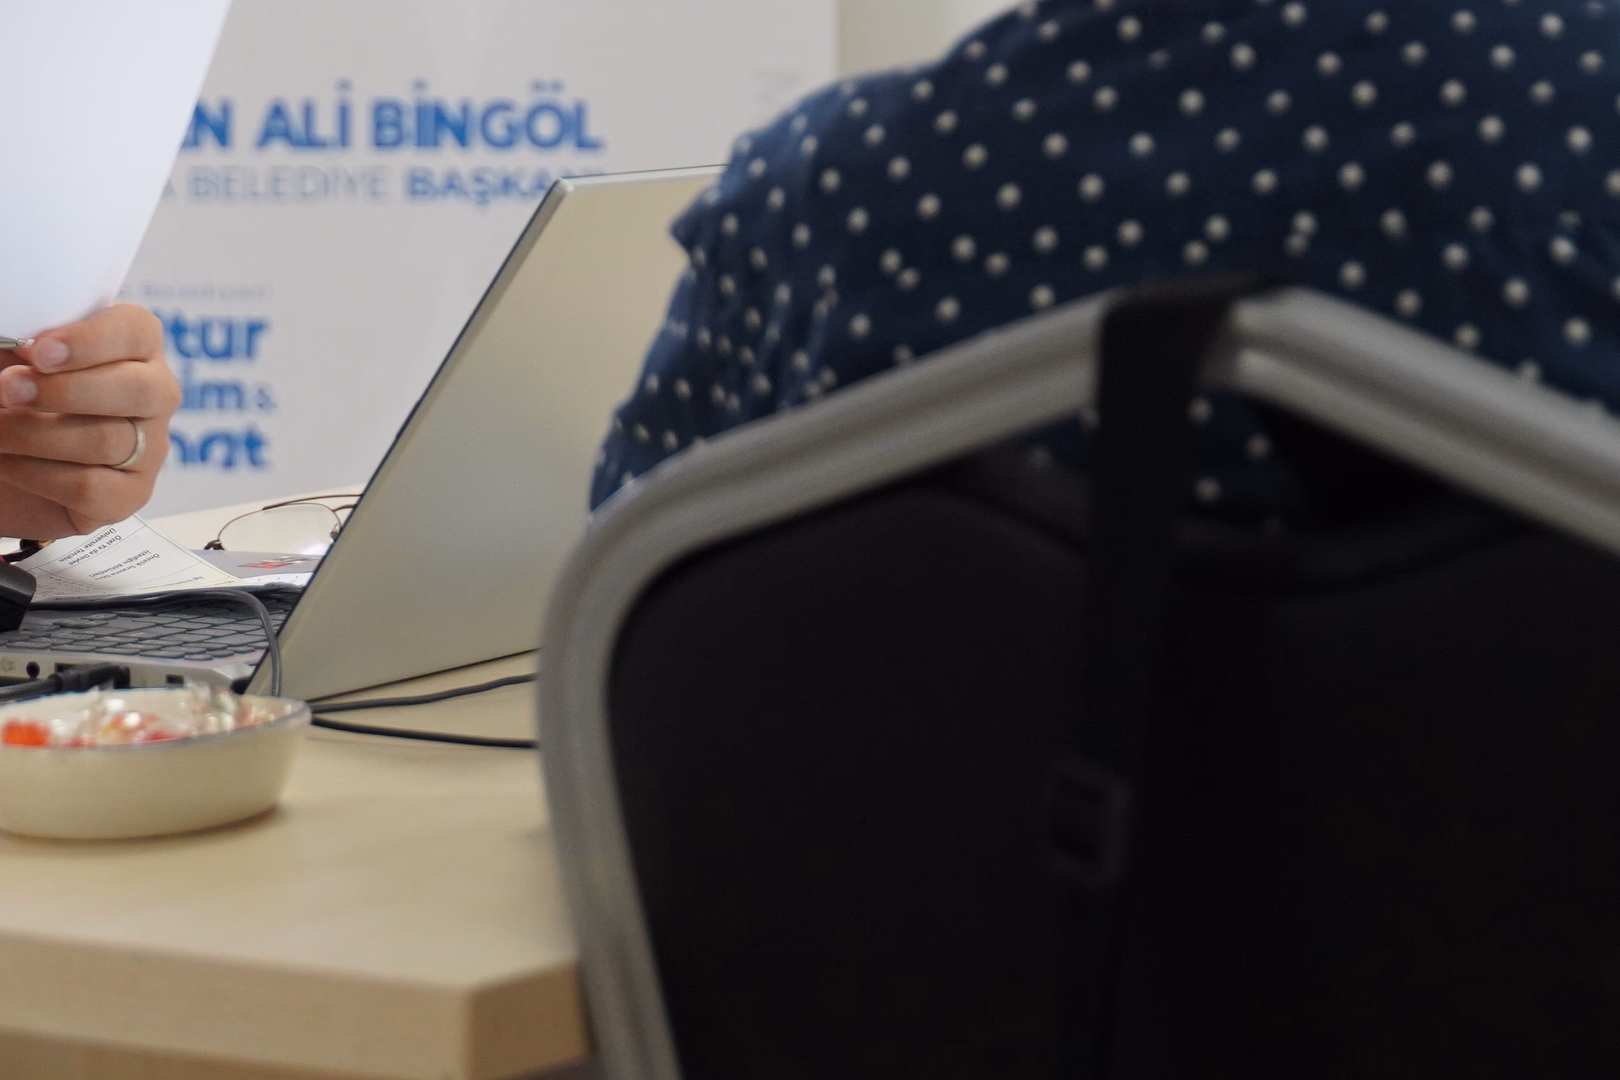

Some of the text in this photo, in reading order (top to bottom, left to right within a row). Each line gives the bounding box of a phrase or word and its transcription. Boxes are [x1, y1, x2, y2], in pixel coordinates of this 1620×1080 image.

[256, 78, 355, 151] ALİ
[370, 78, 605, 151] BİNGÖL
[407, 164, 604, 208] BAŞKA
